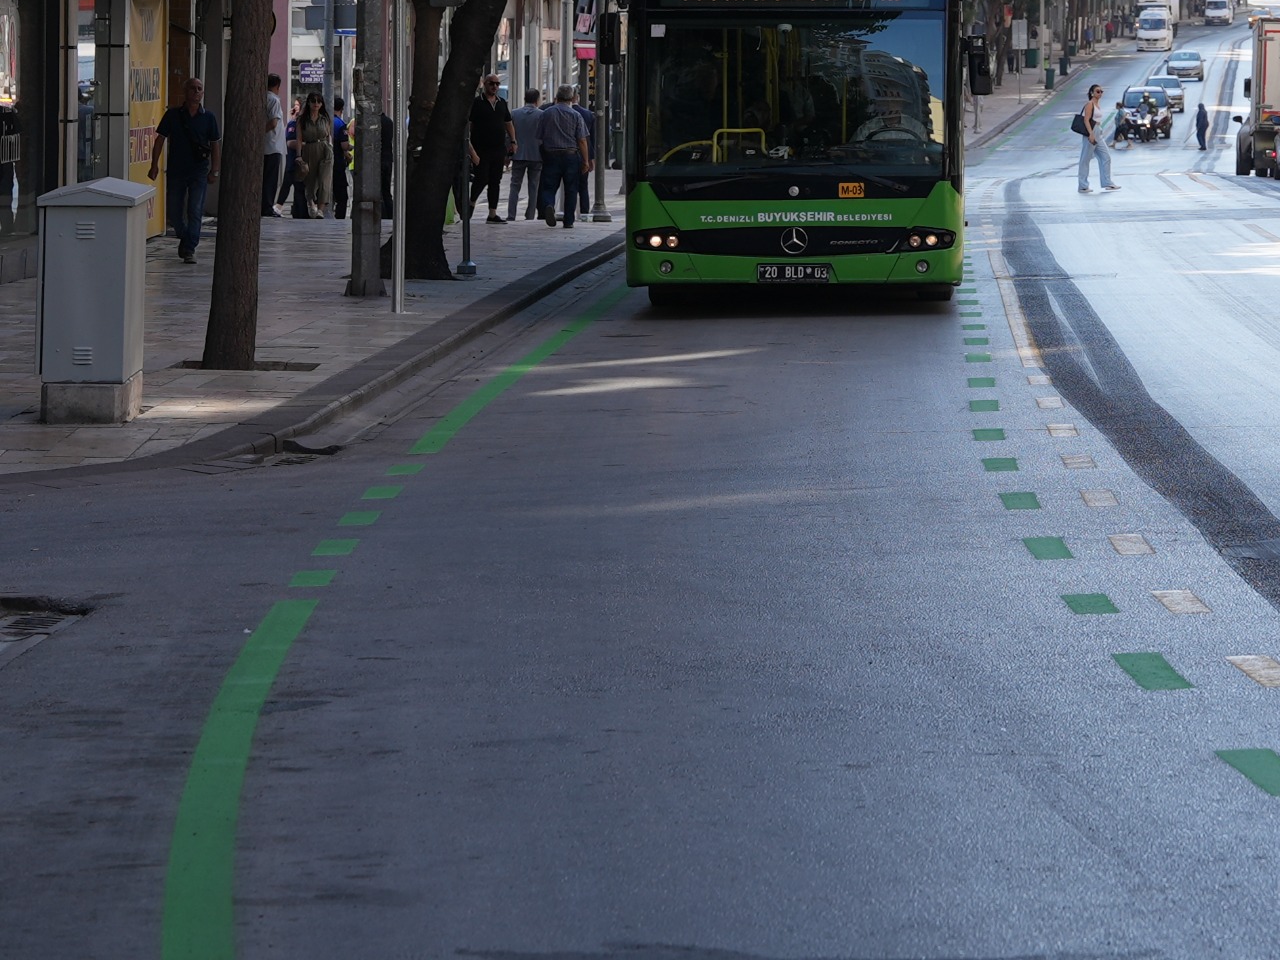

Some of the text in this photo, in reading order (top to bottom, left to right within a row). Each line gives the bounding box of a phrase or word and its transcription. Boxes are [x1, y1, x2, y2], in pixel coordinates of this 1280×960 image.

[841, 185, 862, 196] M-03
[765, 267, 778, 278] 20
[785, 266, 804, 278] BLD
